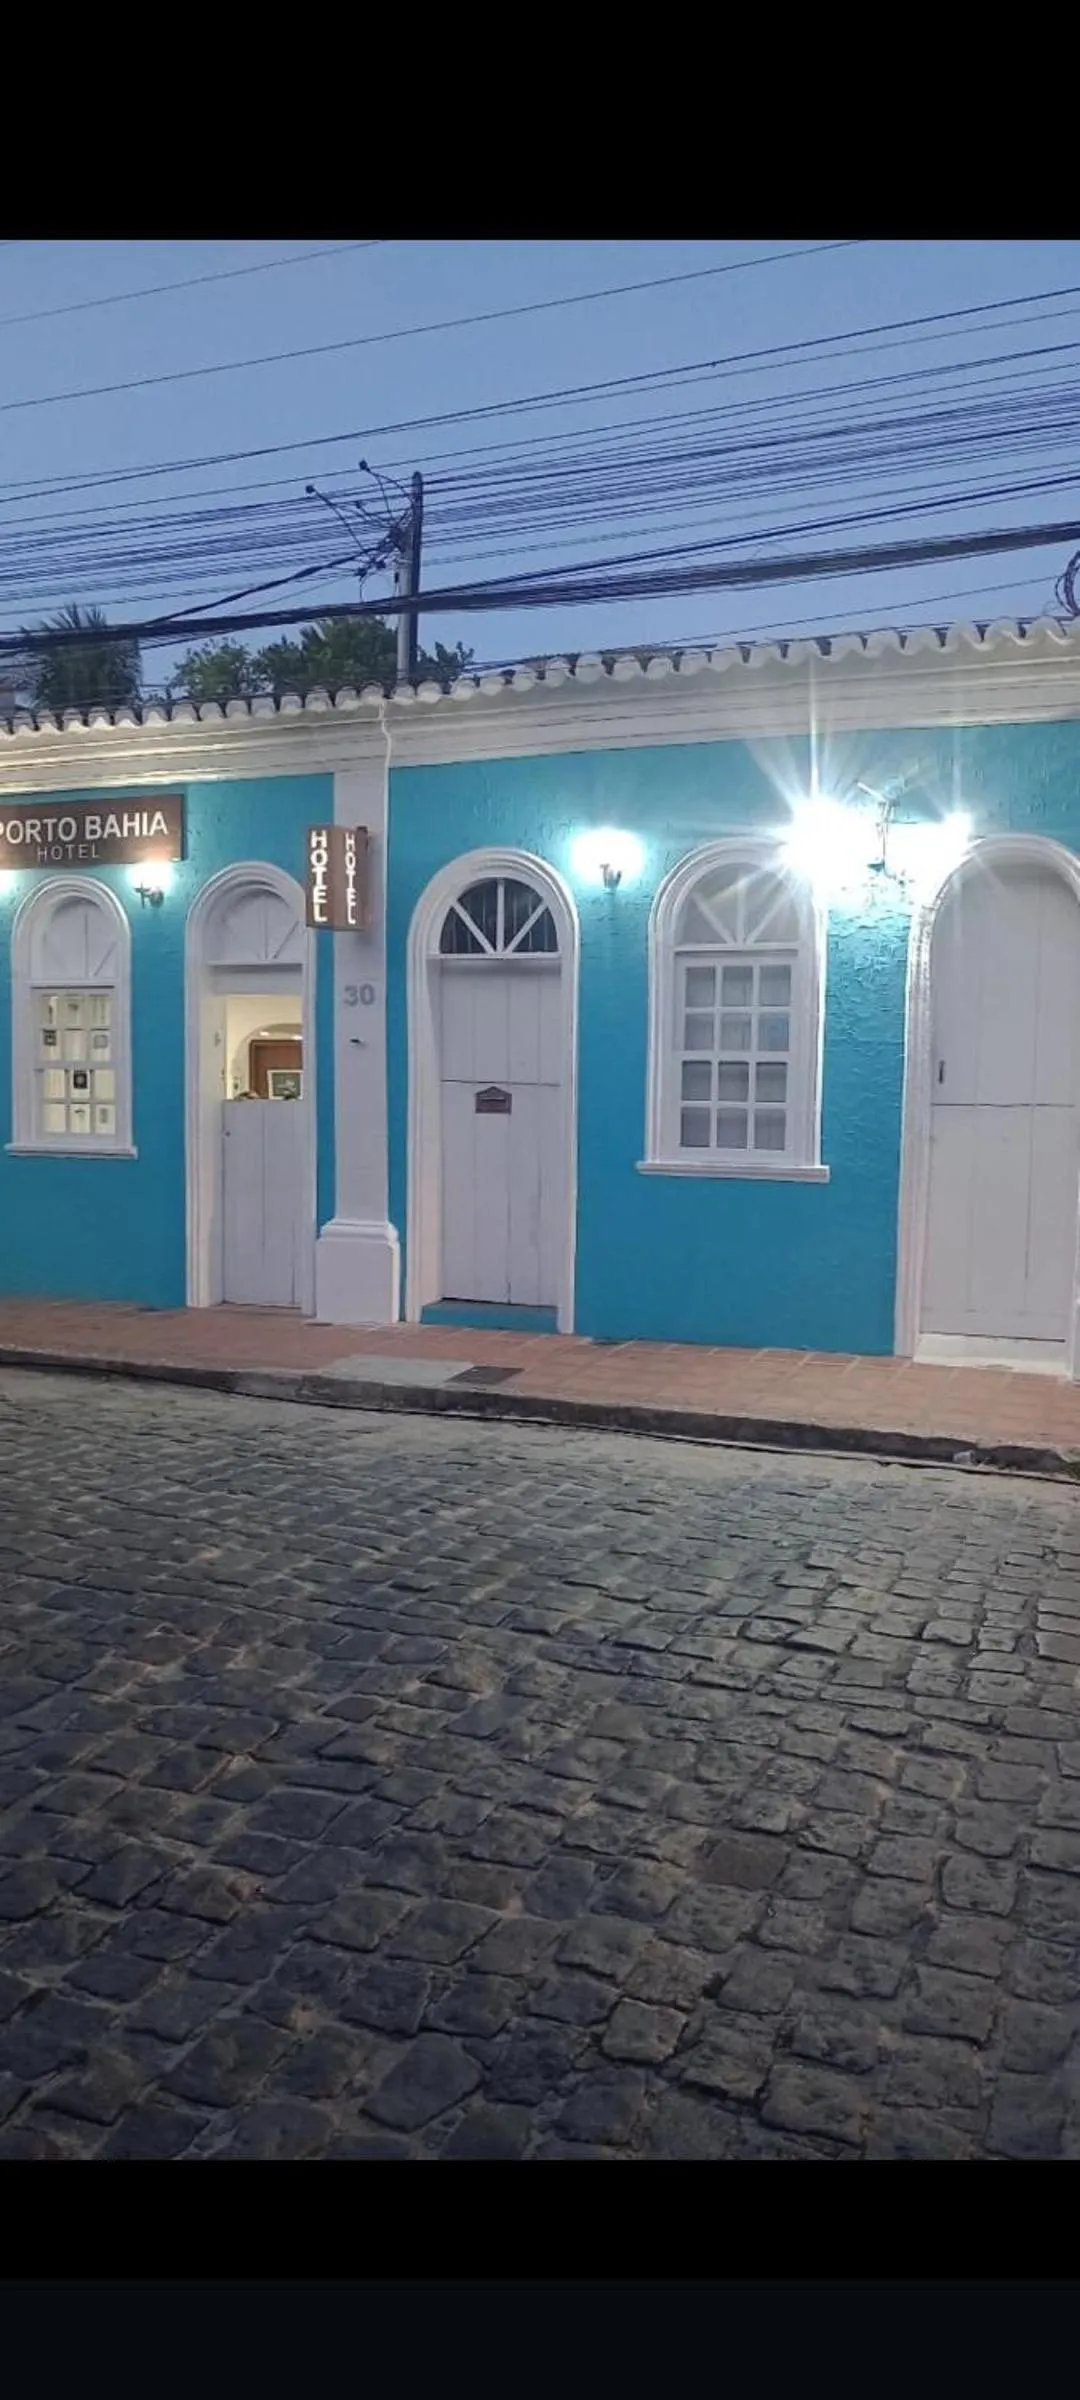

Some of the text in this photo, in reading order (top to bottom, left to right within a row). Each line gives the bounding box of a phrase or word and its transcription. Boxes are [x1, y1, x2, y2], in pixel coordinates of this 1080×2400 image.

[0, 811, 169, 844] ORTO BAHIA
[36, 843, 101, 861] HOTEL
[310, 829, 329, 923] HOTEL
[344, 832, 358, 925] HOTEL
[344, 983, 376, 1007] 30
